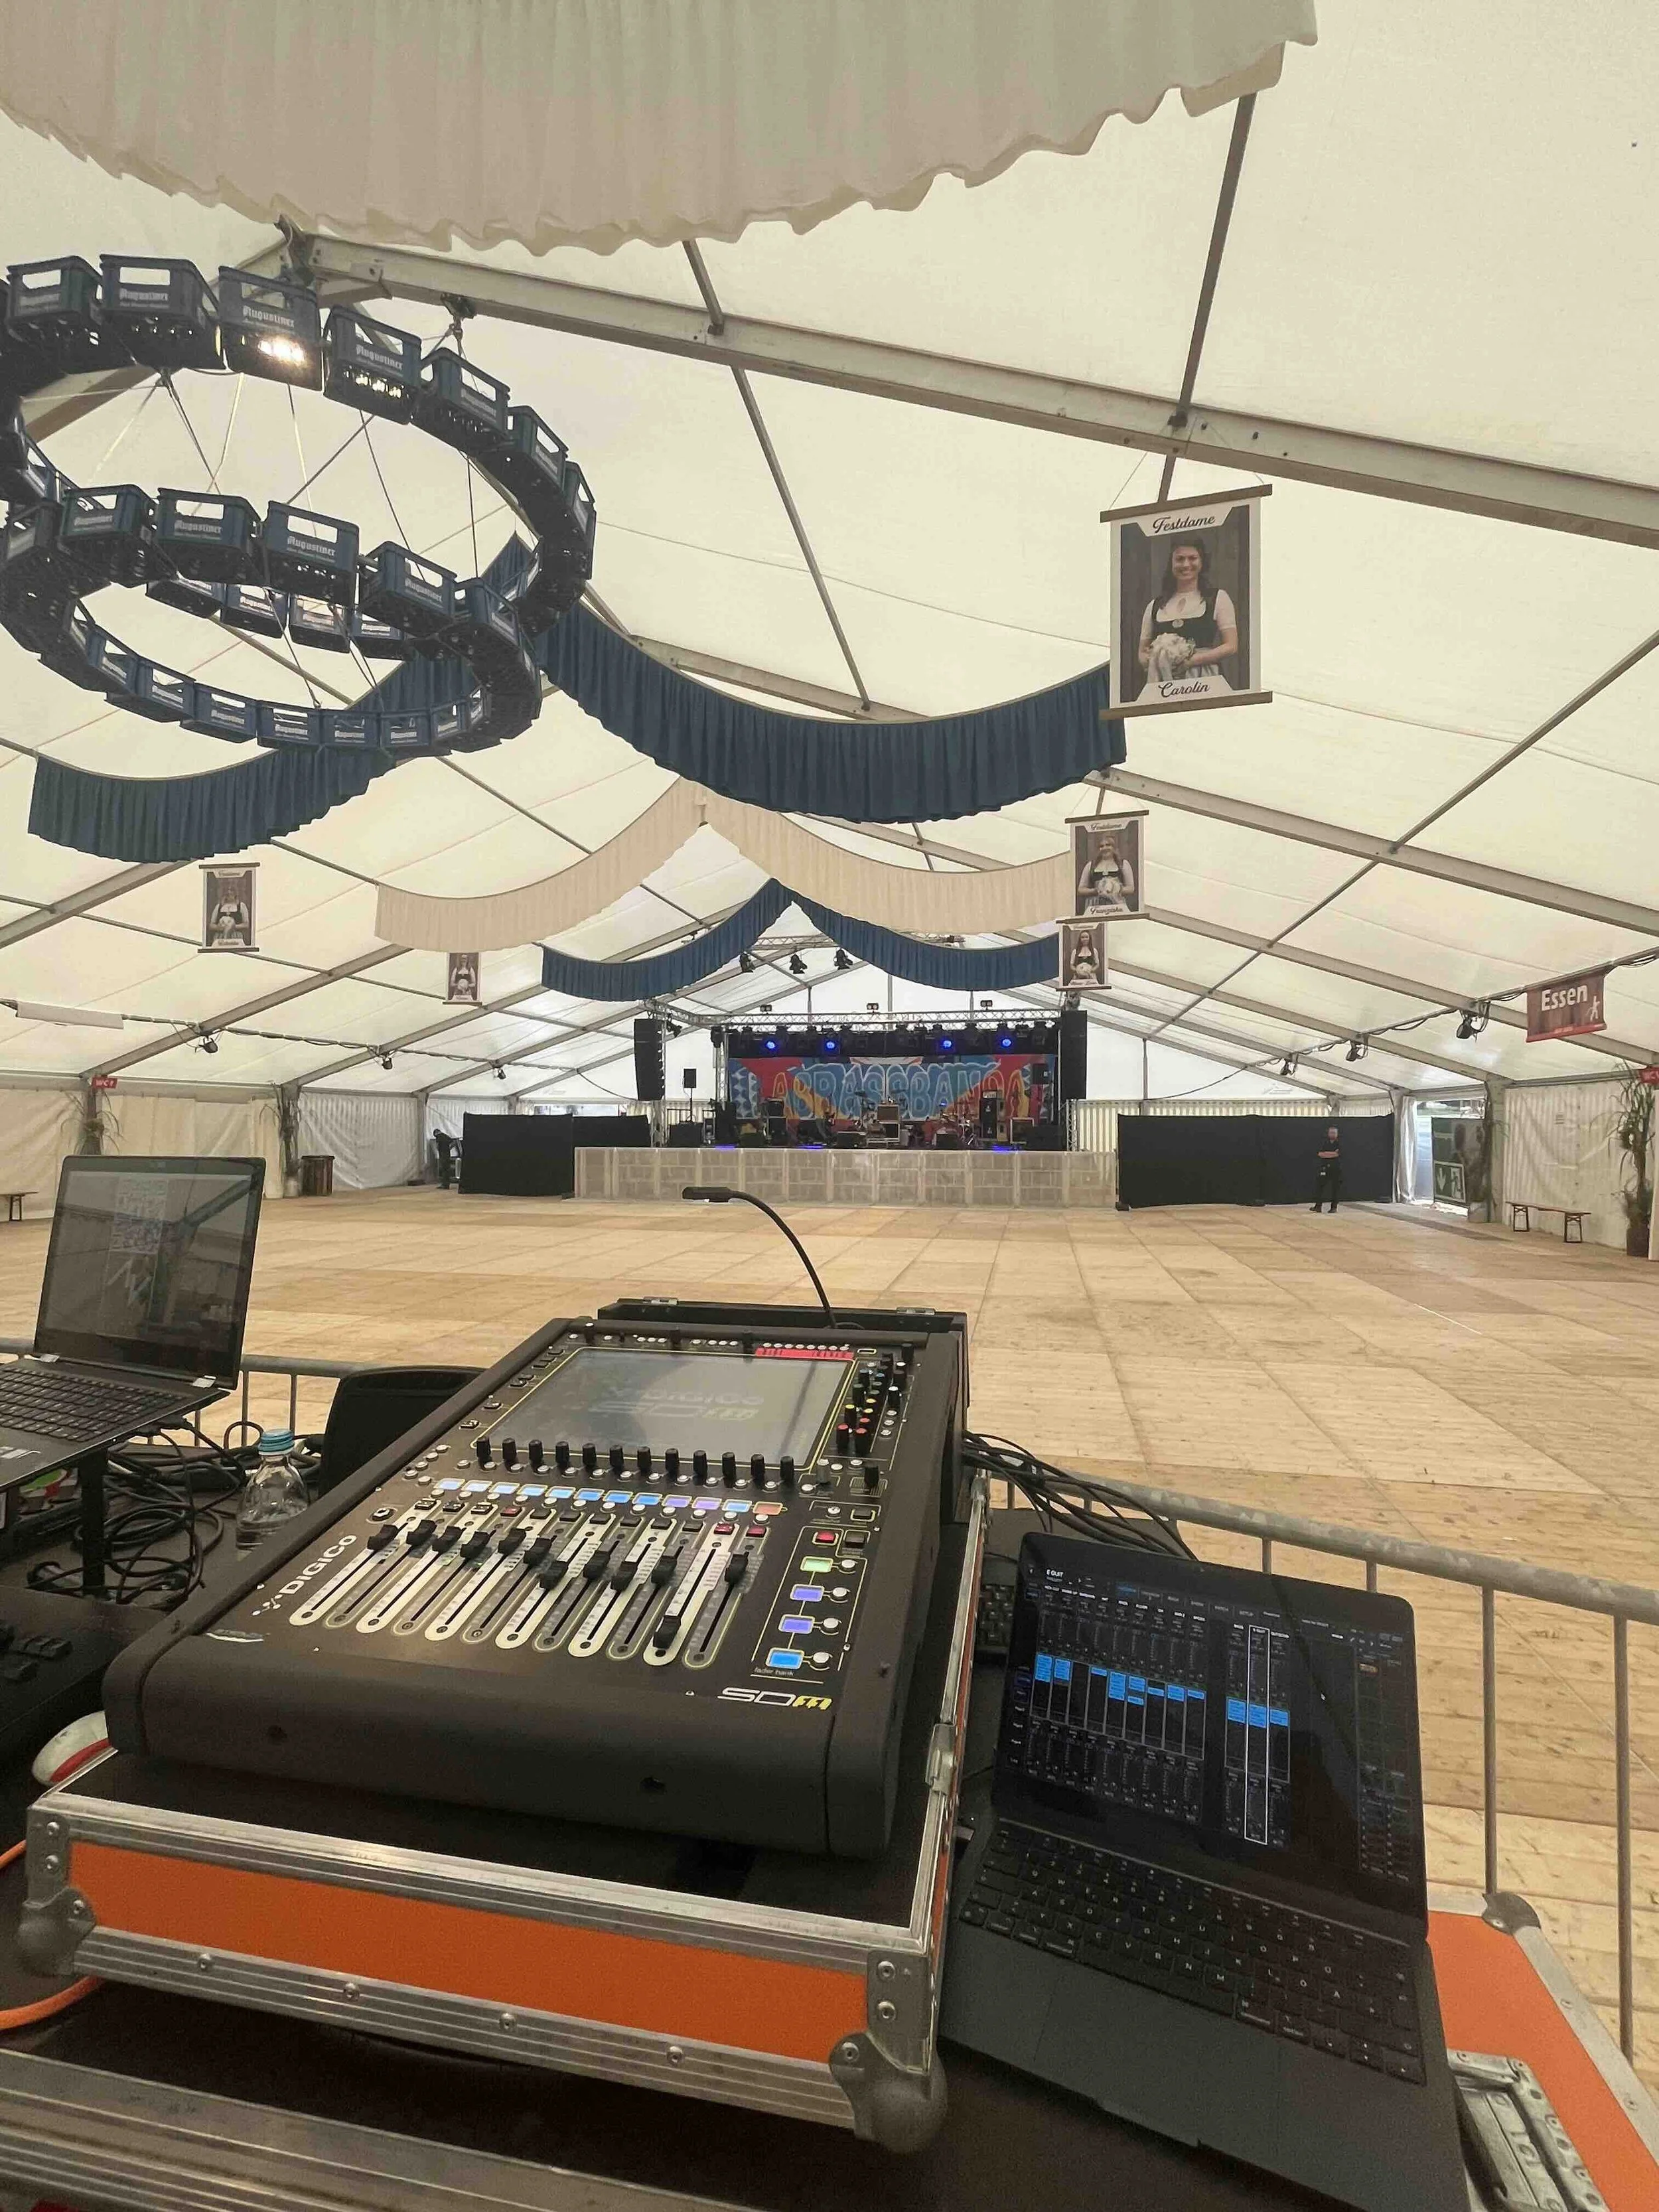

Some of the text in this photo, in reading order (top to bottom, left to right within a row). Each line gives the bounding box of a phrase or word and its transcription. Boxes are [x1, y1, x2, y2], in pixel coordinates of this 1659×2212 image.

[1152, 513, 1216, 534] Festdame
[1158, 681, 1210, 698] Carolin
[1541, 985, 1587, 1011] Essen
